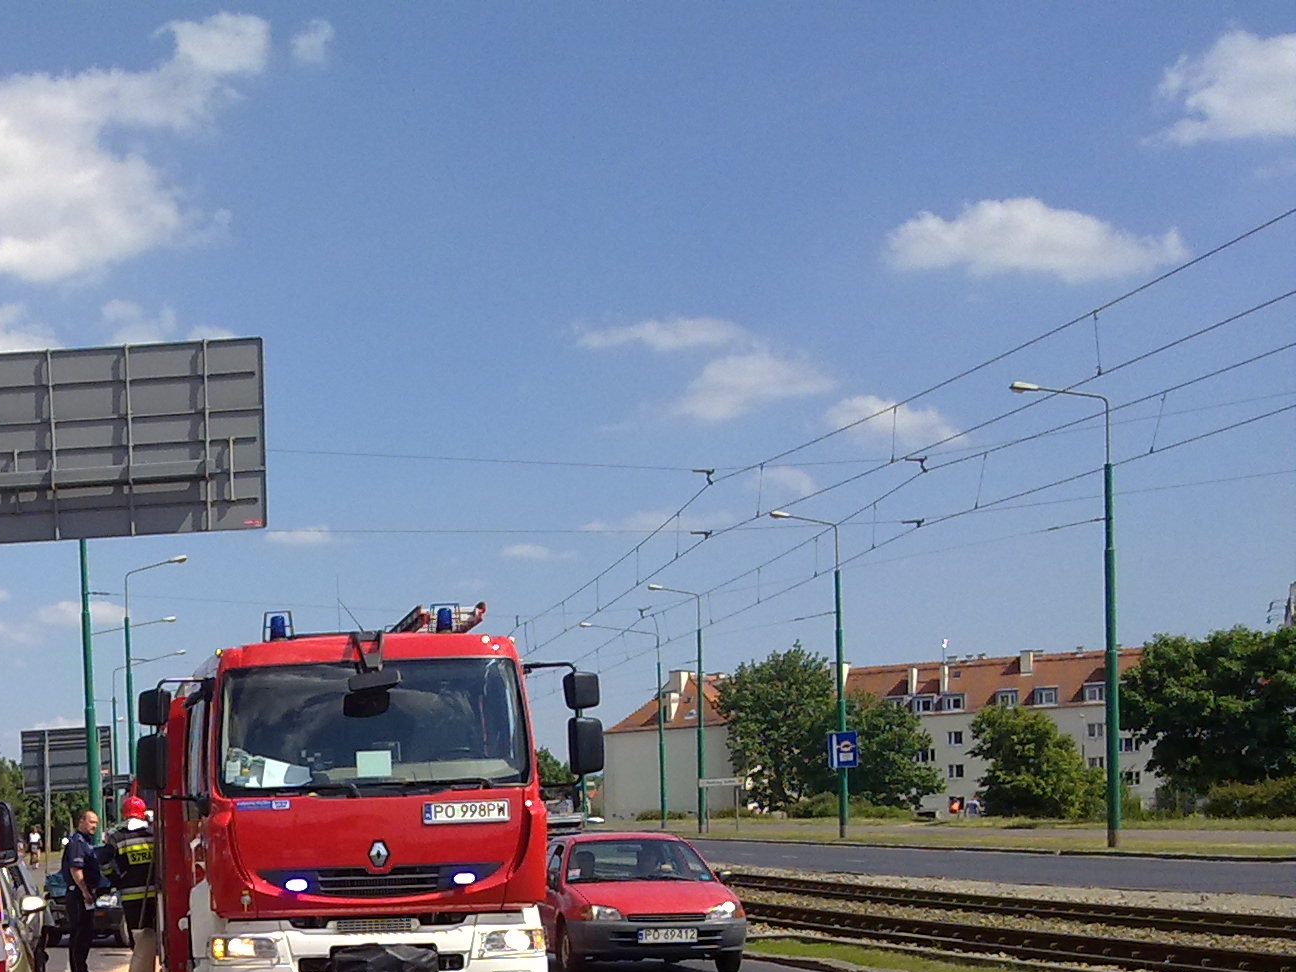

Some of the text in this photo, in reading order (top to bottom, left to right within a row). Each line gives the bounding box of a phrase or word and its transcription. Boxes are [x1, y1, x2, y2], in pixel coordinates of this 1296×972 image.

[434, 804, 455, 819] PO
[645, 928, 696, 940] PO 69412
